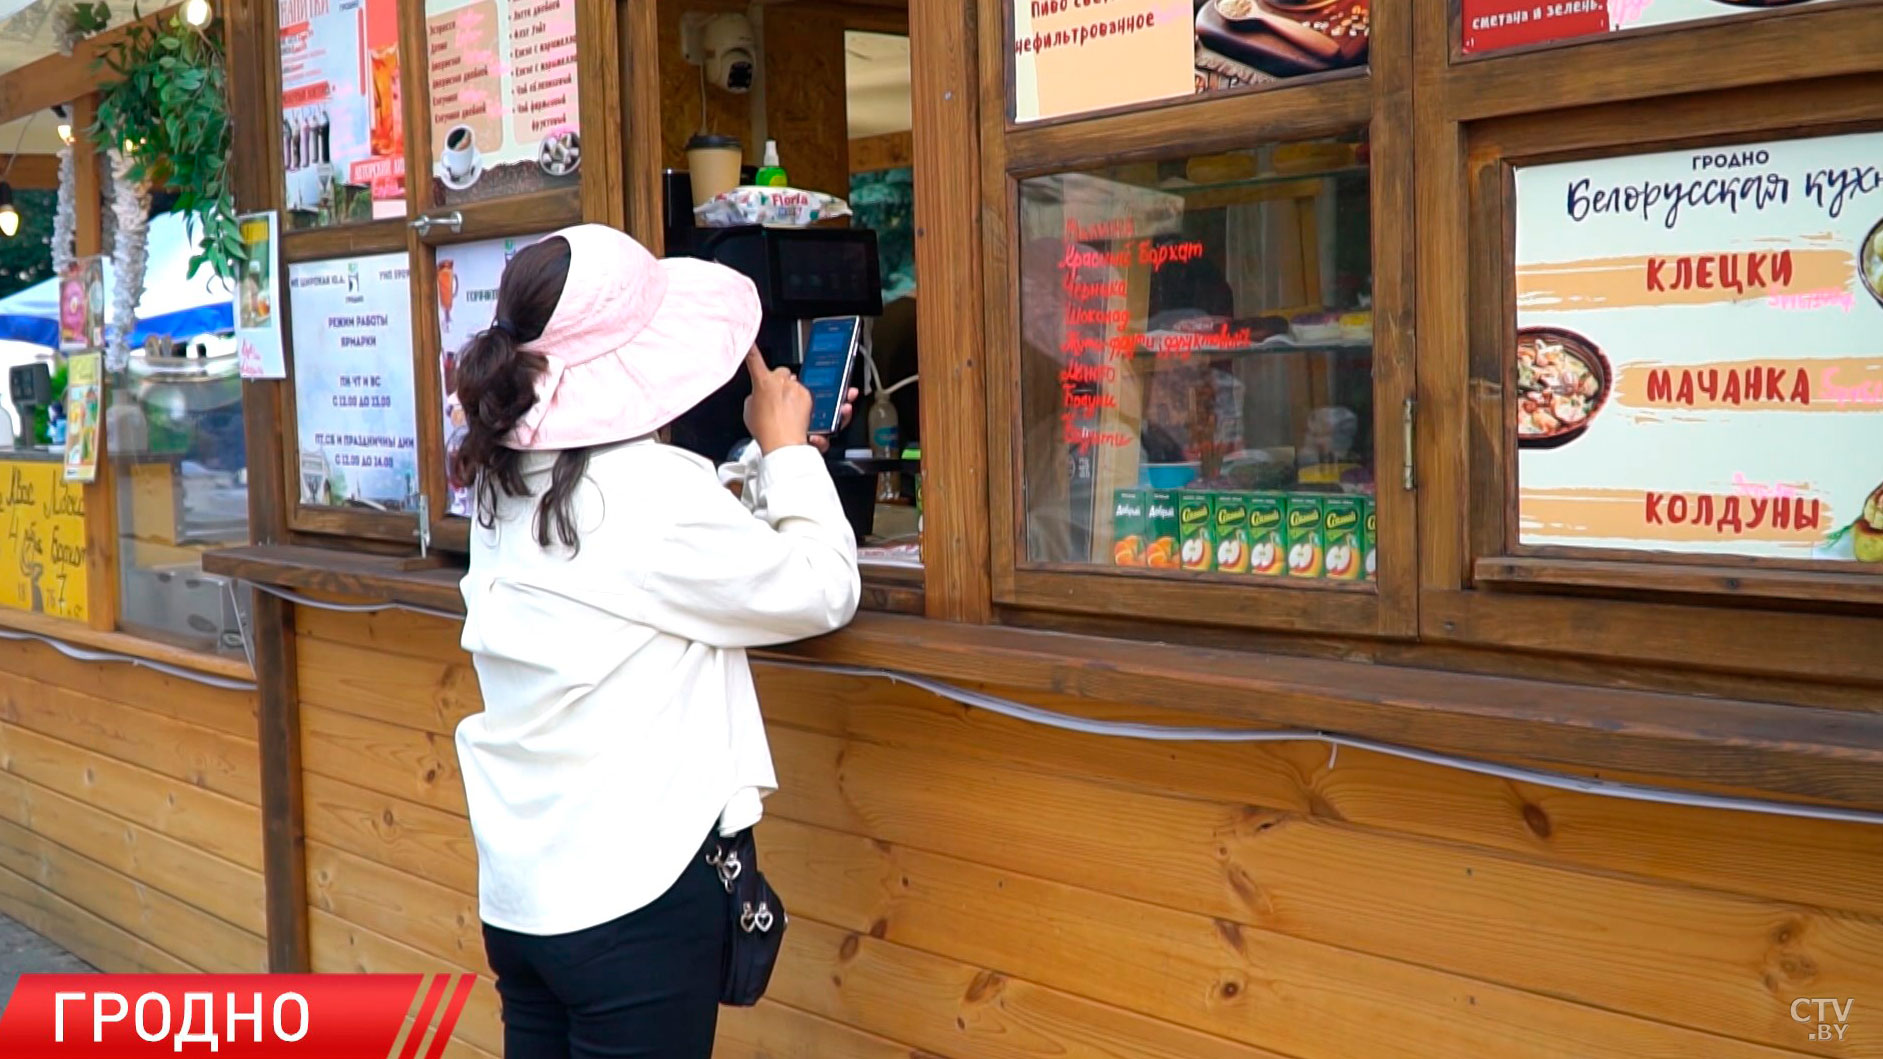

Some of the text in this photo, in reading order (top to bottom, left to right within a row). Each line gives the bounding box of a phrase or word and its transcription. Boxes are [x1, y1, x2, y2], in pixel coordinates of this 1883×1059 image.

[1031, 0, 1067, 18] Пиво
[1472, 10, 1528, 30] сметана
[1015, 12, 1155, 54] нефильтрованное
[1692, 150, 1770, 170] ГРОДНО
[1567, 173, 1790, 228] Белорусская
[1647, 250, 1792, 294] КЛЕЦКИ
[328, 314, 388, 328] РЕЖИМ РАБОТЫ
[1647, 366, 1810, 405] МАЧАНКА
[359, 397, 370, 407] ДО
[1645, 492, 1820, 534] КОЛДУНЫ
